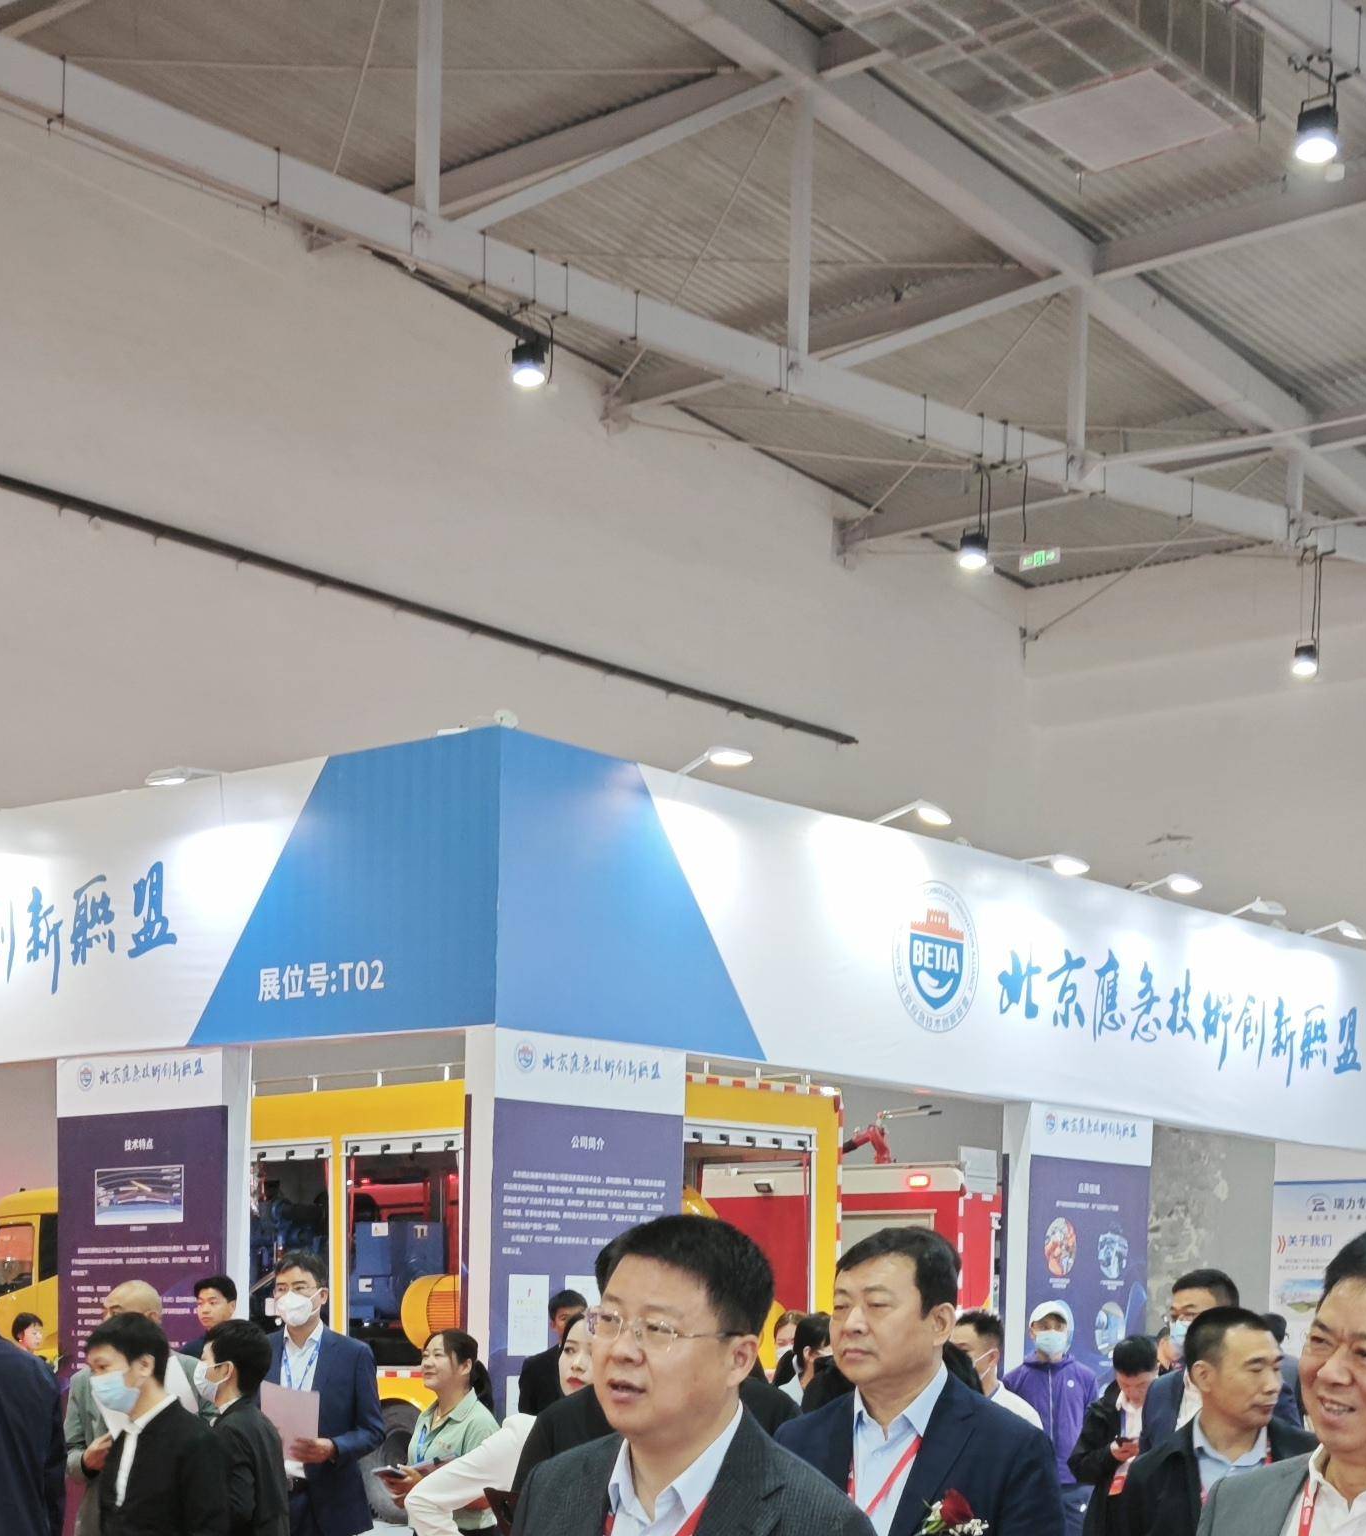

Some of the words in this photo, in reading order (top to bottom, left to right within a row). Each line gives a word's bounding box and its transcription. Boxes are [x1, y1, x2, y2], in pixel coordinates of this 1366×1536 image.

[912, 938, 960, 975] BETIA
[257, 959, 386, 1003] 展位号:T02
[124, 1138, 154, 1151] 技术特点
[570, 1135, 605, 1151] 公司简介
[1288, 1234, 1332, 1248] 关于我们
